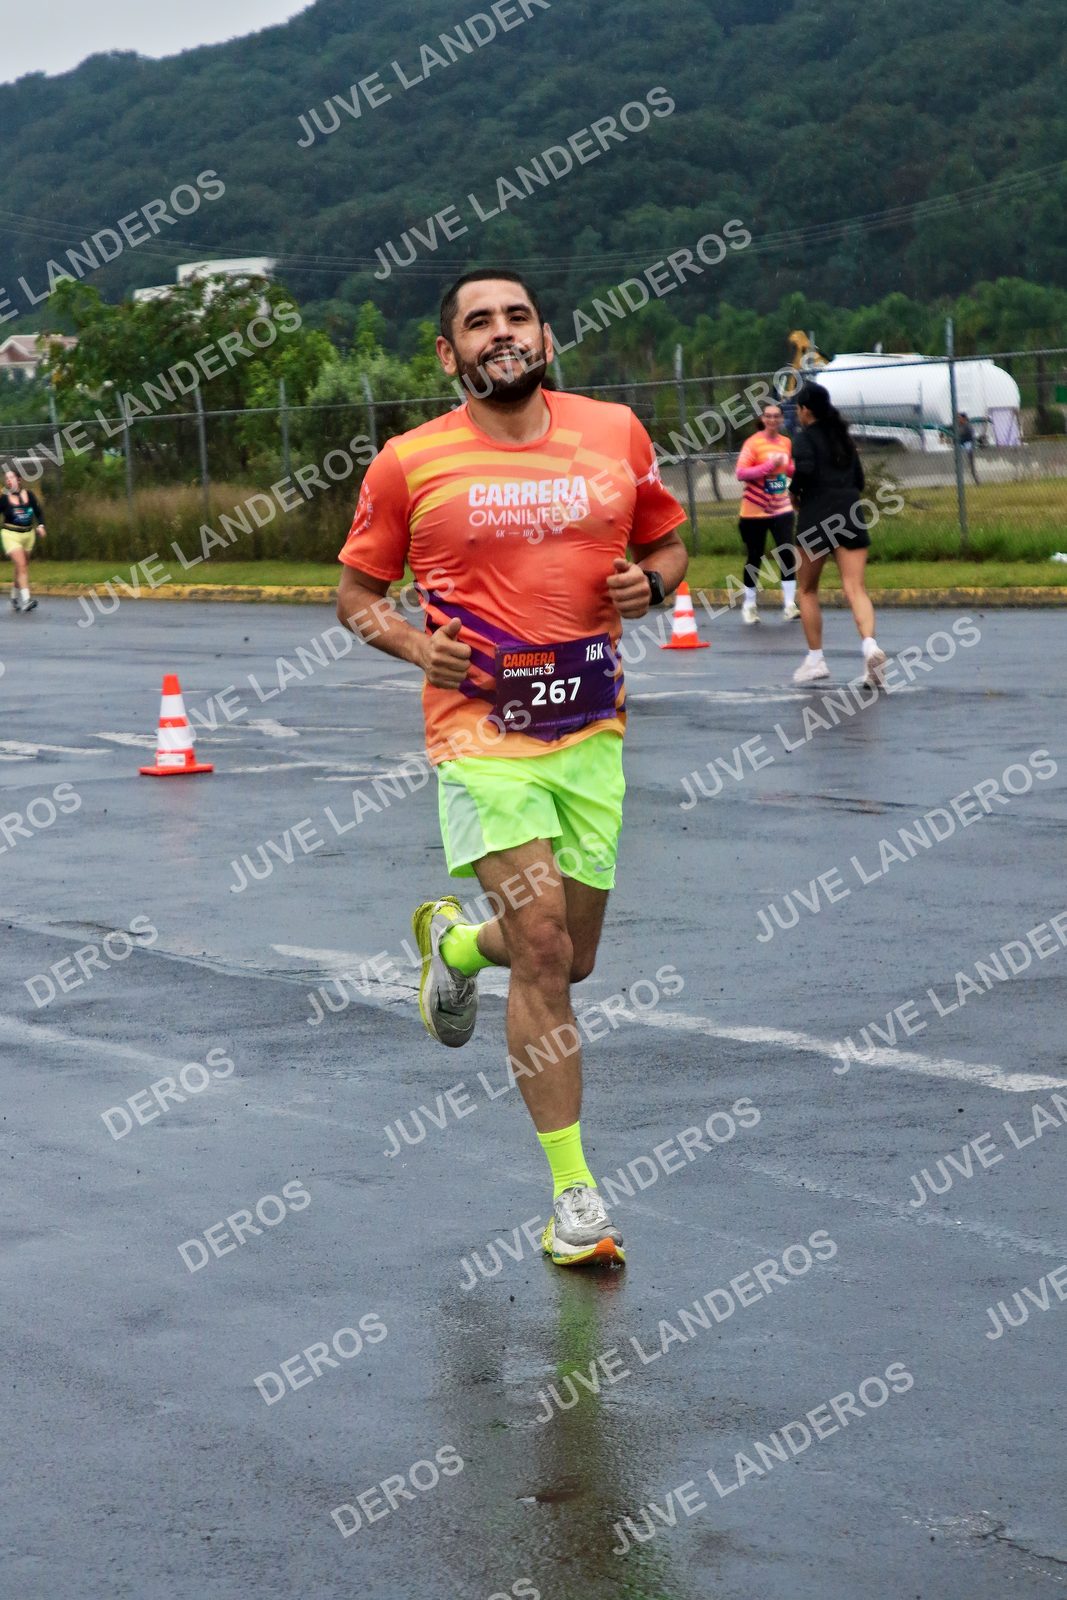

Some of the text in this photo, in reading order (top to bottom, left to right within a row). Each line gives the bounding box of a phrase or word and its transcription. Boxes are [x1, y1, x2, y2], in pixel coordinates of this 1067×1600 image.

[468, 475, 588, 507] CARRERA
[503, 651, 556, 668] CARRERA
[586, 643, 604, 662] 15K
[531, 677, 581, 706] 267
